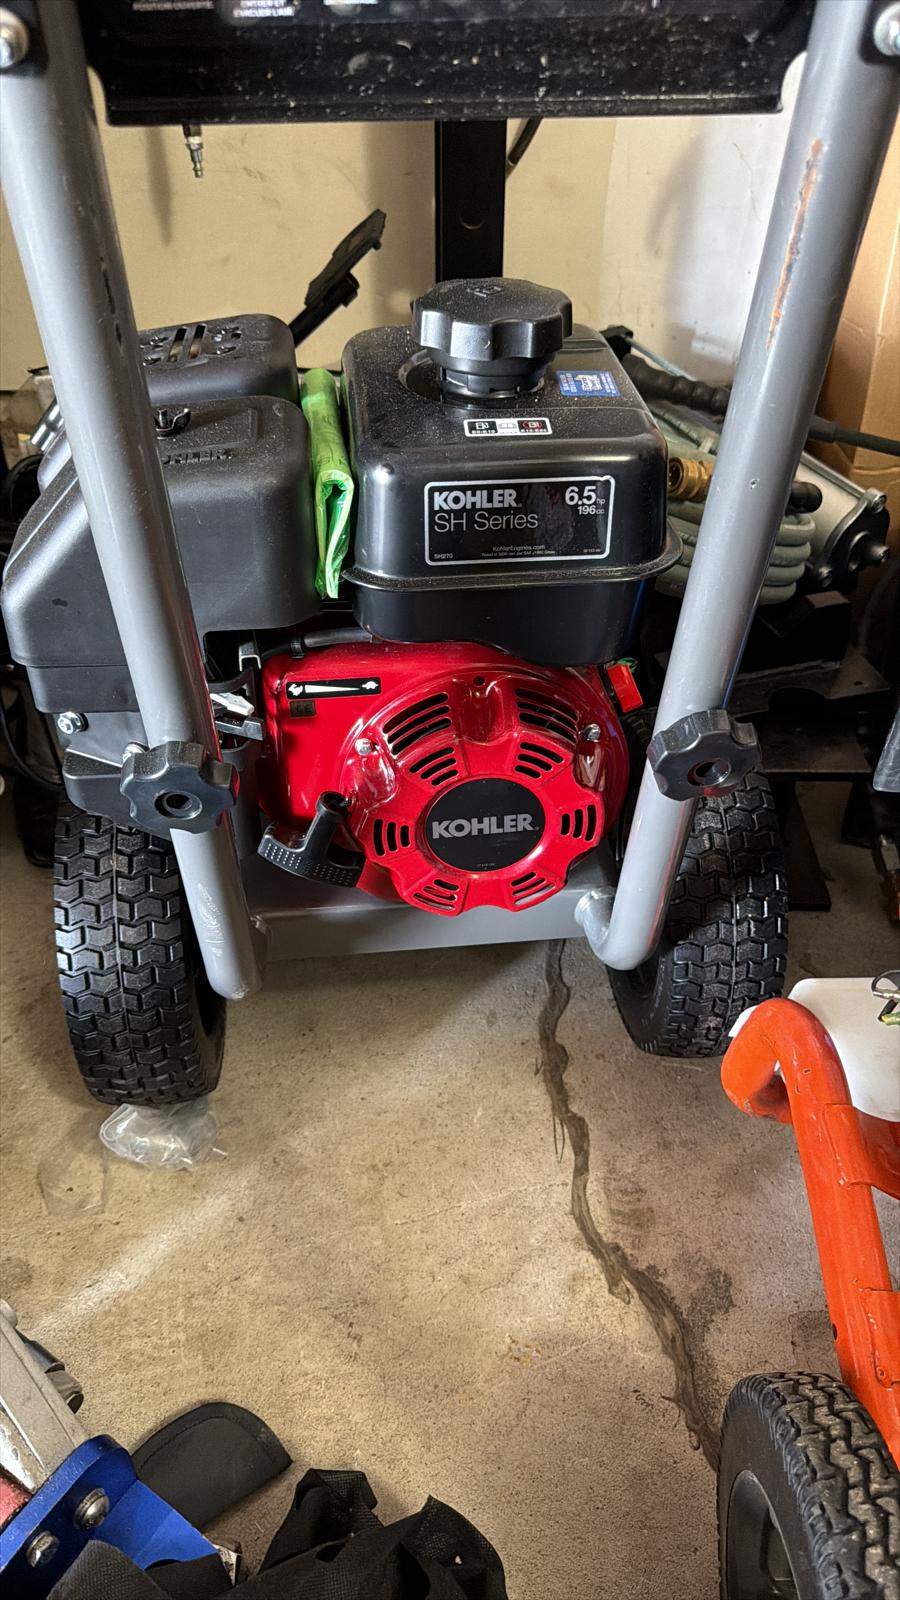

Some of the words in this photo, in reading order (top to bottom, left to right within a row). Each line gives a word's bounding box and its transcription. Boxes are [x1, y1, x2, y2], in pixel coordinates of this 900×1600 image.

[433, 489, 519, 510] KOHLER
[565, 485, 597, 505] 6.5
[577, 505, 596, 515] 196
[434, 512, 466, 532] SH
[474, 510, 538, 531] Series
[432, 813, 536, 839] KOHLER
